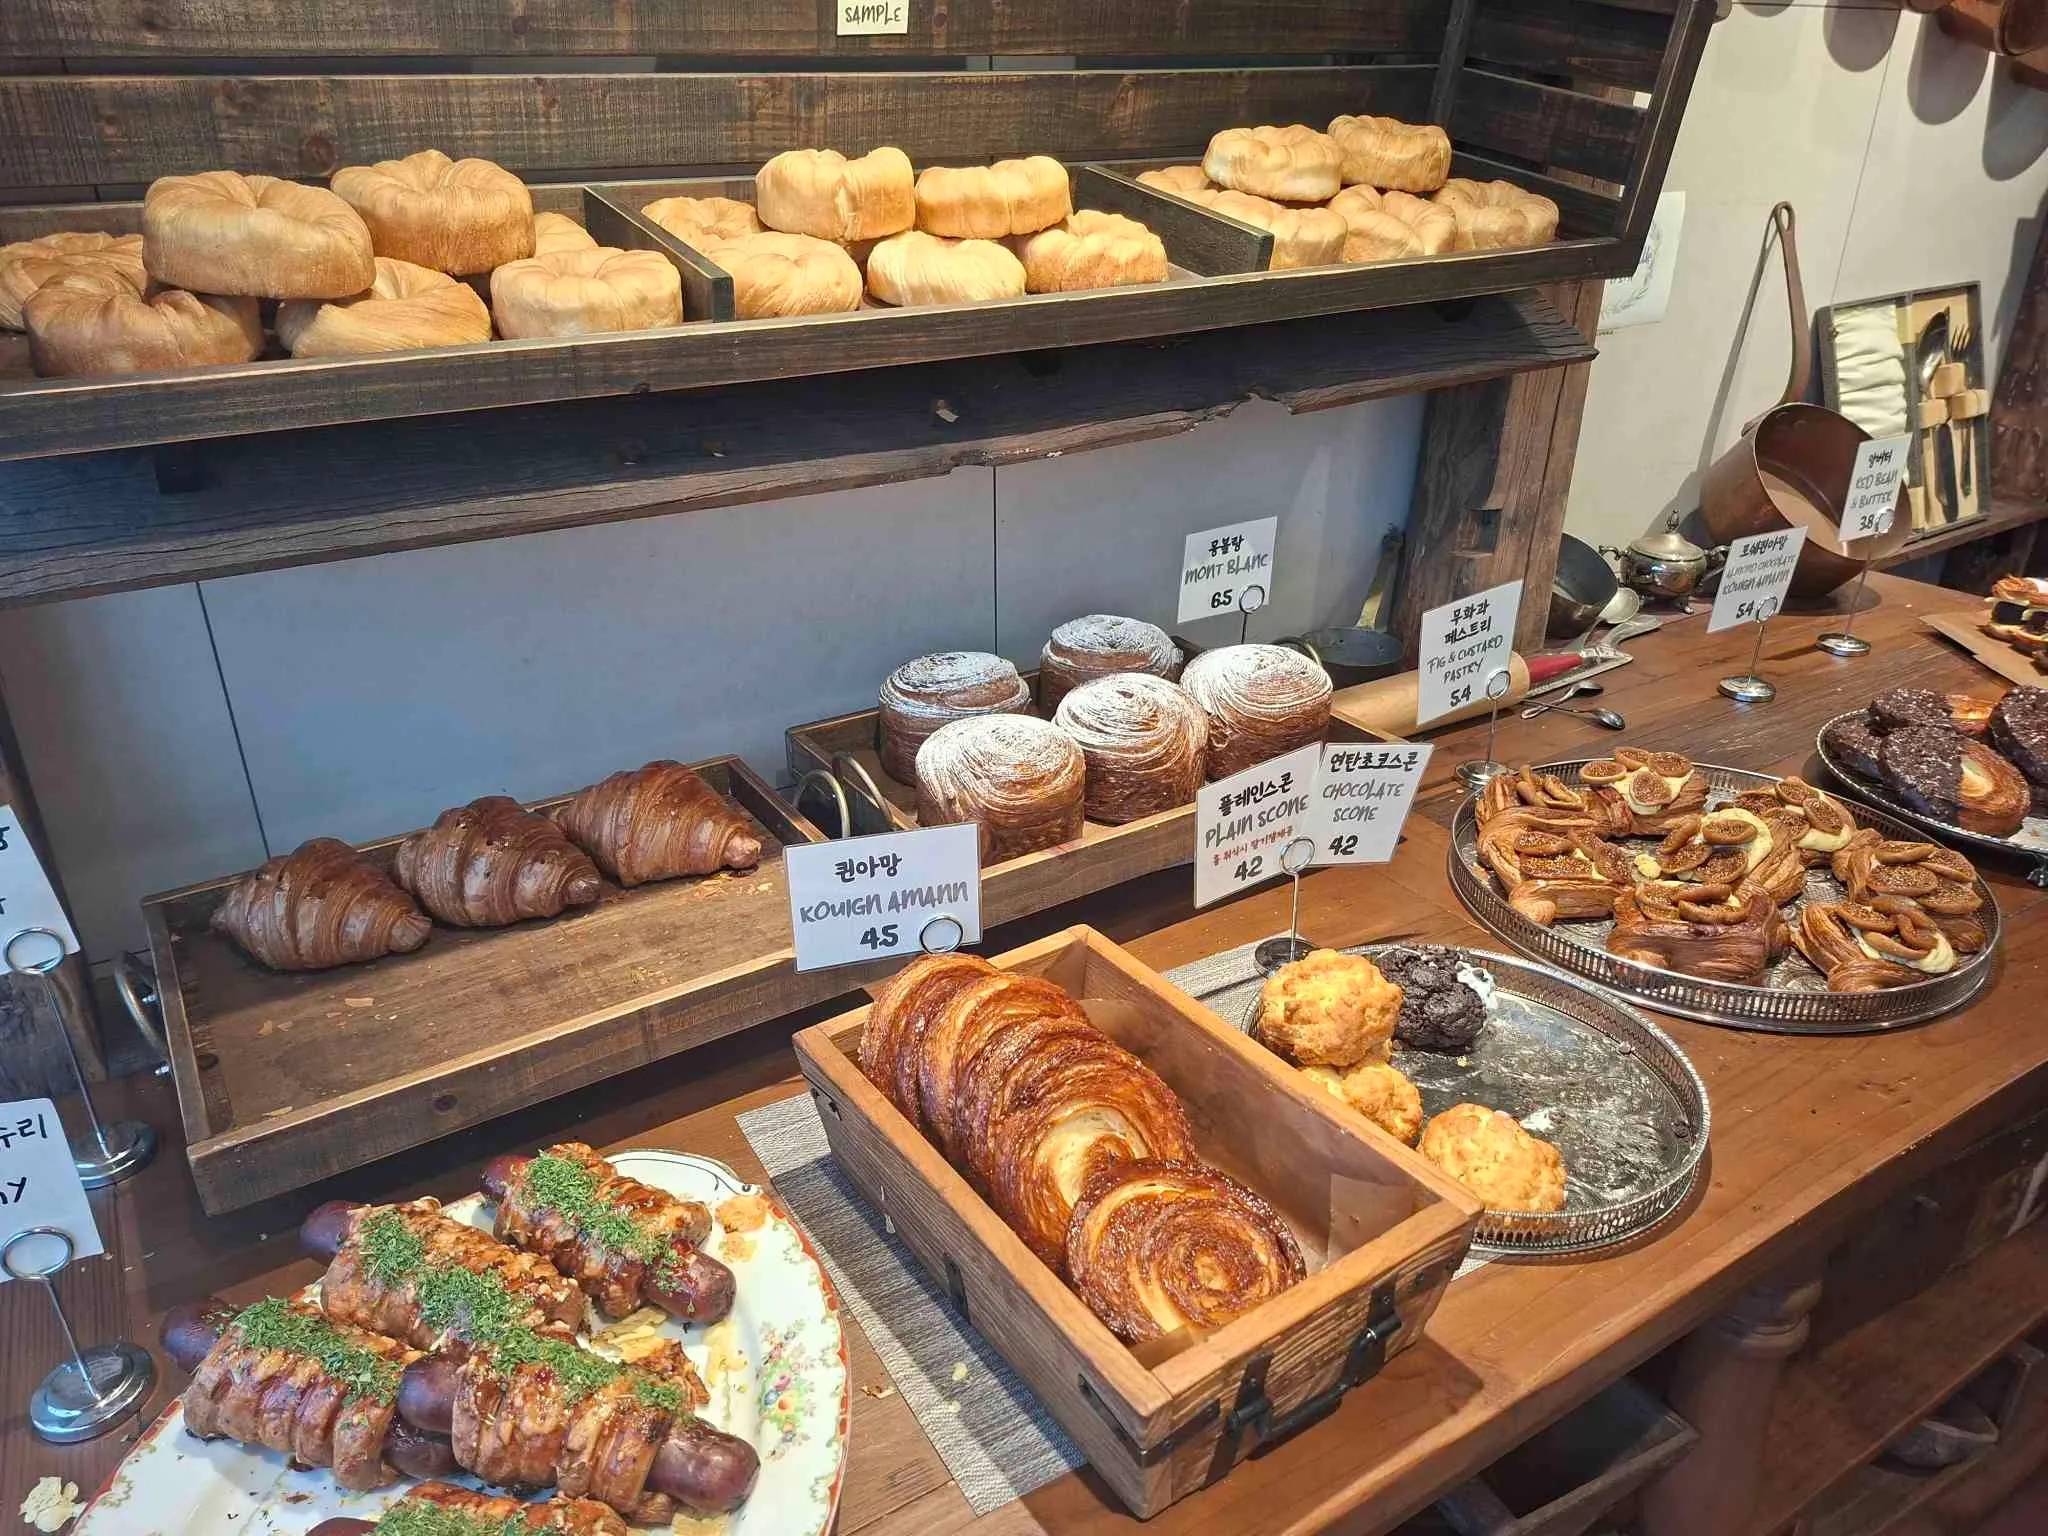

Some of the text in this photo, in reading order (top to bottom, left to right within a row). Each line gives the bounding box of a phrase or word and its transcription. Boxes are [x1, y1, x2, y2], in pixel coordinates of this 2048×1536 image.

[845, 2, 902, 25] SAMPLE
[1184, 554, 1269, 585] MONT BLANC
[1451, 599, 1490, 625] 무화과
[1444, 616, 1492, 644] 페스트리
[1427, 656, 1446, 674] FIG
[1457, 635, 1503, 660] CUSTARD
[1444, 657, 1484, 684] PASTRY
[1330, 751, 1419, 772] 연탄초코스콘
[1218, 771, 1294, 817] 플레인스콘
[1322, 778, 1405, 801] CHOCOLATE
[1205, 794, 1309, 849] PLAIN SCONE
[1332, 806, 1379, 823] SCONE
[834, 852, 903, 884] 퀸아망
[800, 881, 969, 923] KOUIGN AMANN
